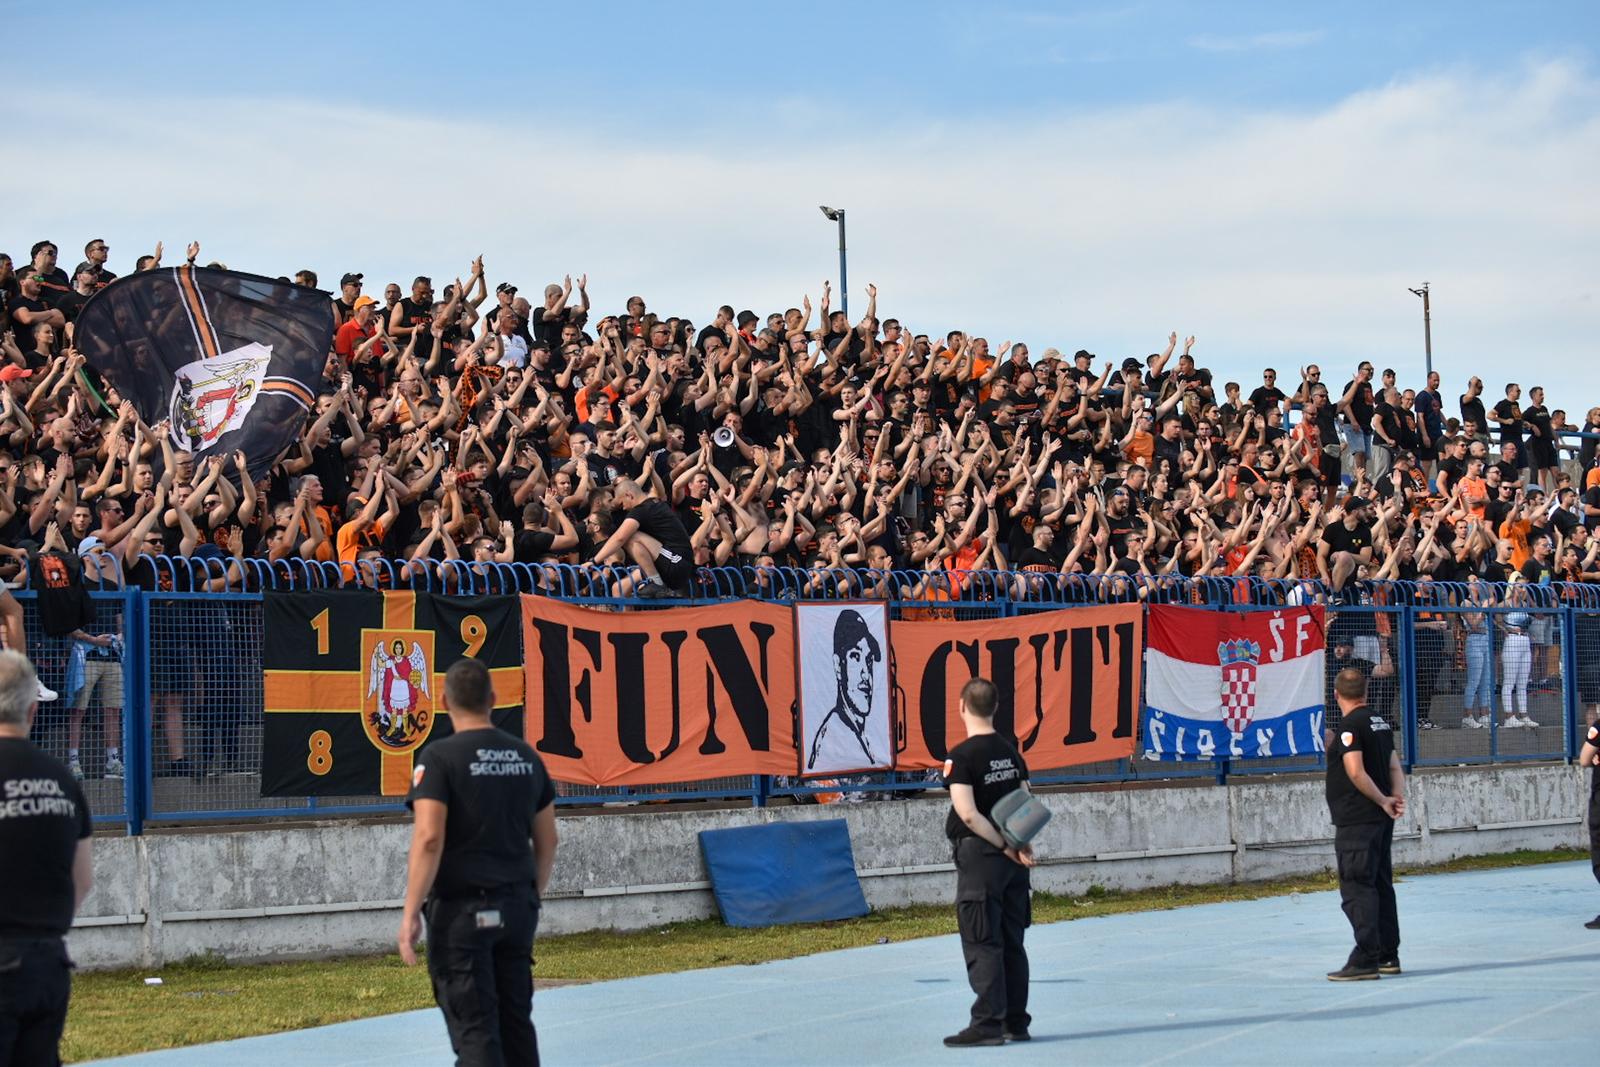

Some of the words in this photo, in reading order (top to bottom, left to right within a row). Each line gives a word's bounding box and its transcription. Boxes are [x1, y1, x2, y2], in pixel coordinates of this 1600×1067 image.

[310, 607, 330, 655] 1
[532, 617, 775, 764] FUN
[919, 622, 1134, 762] CUTI
[307, 729, 333, 776] 8
[476, 749, 523, 762] SOKOL
[469, 762, 534, 777] SECURITY
[989, 758, 1015, 771] SOKOL
[4, 779, 65, 798] SOKOL
